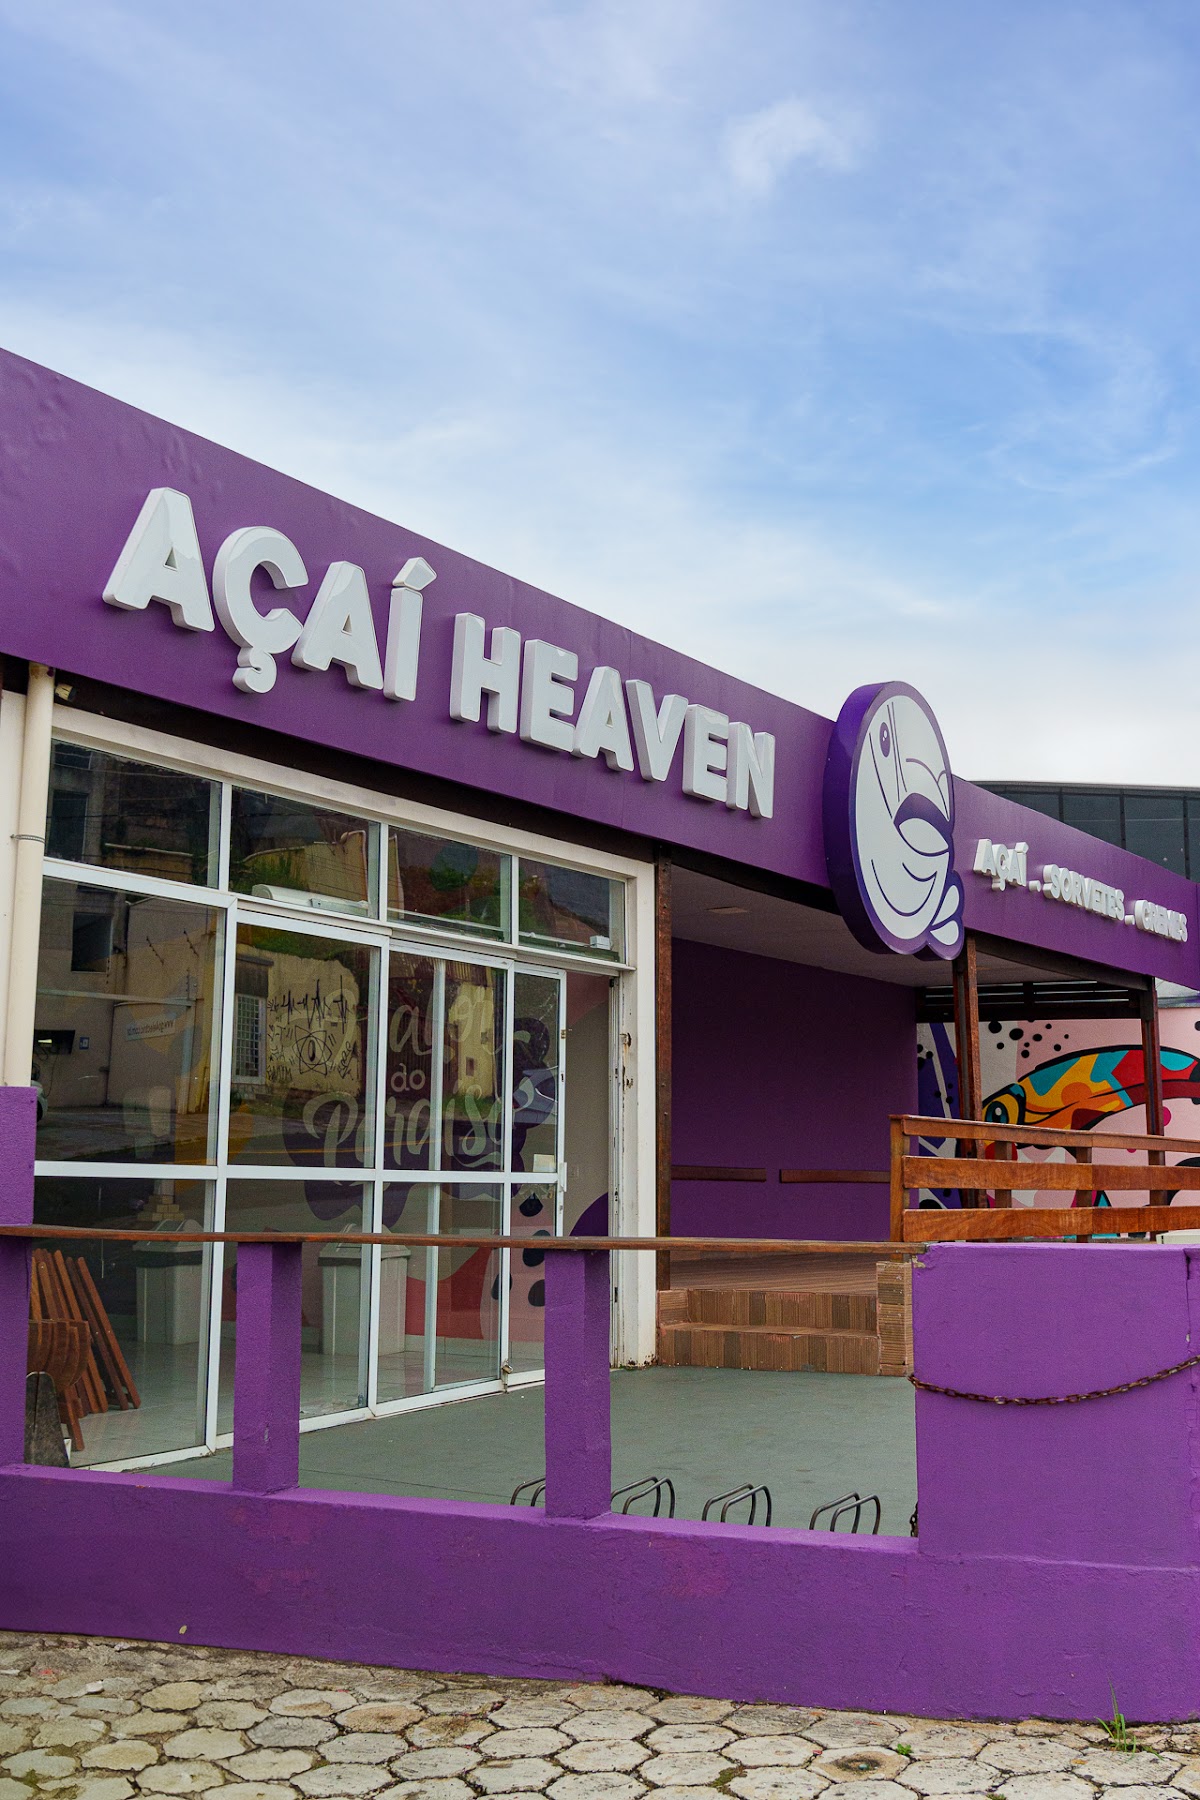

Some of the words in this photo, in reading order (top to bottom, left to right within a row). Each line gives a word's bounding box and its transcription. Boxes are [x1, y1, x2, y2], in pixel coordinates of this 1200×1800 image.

[102, 487, 437, 701] AÇAÍ
[449, 612, 775, 819] HEAVEN
[973, 838, 1029, 891] AÇAÍ
[1043, 864, 1125, 921] SORVETES
[390, 1062, 426, 1092] do
